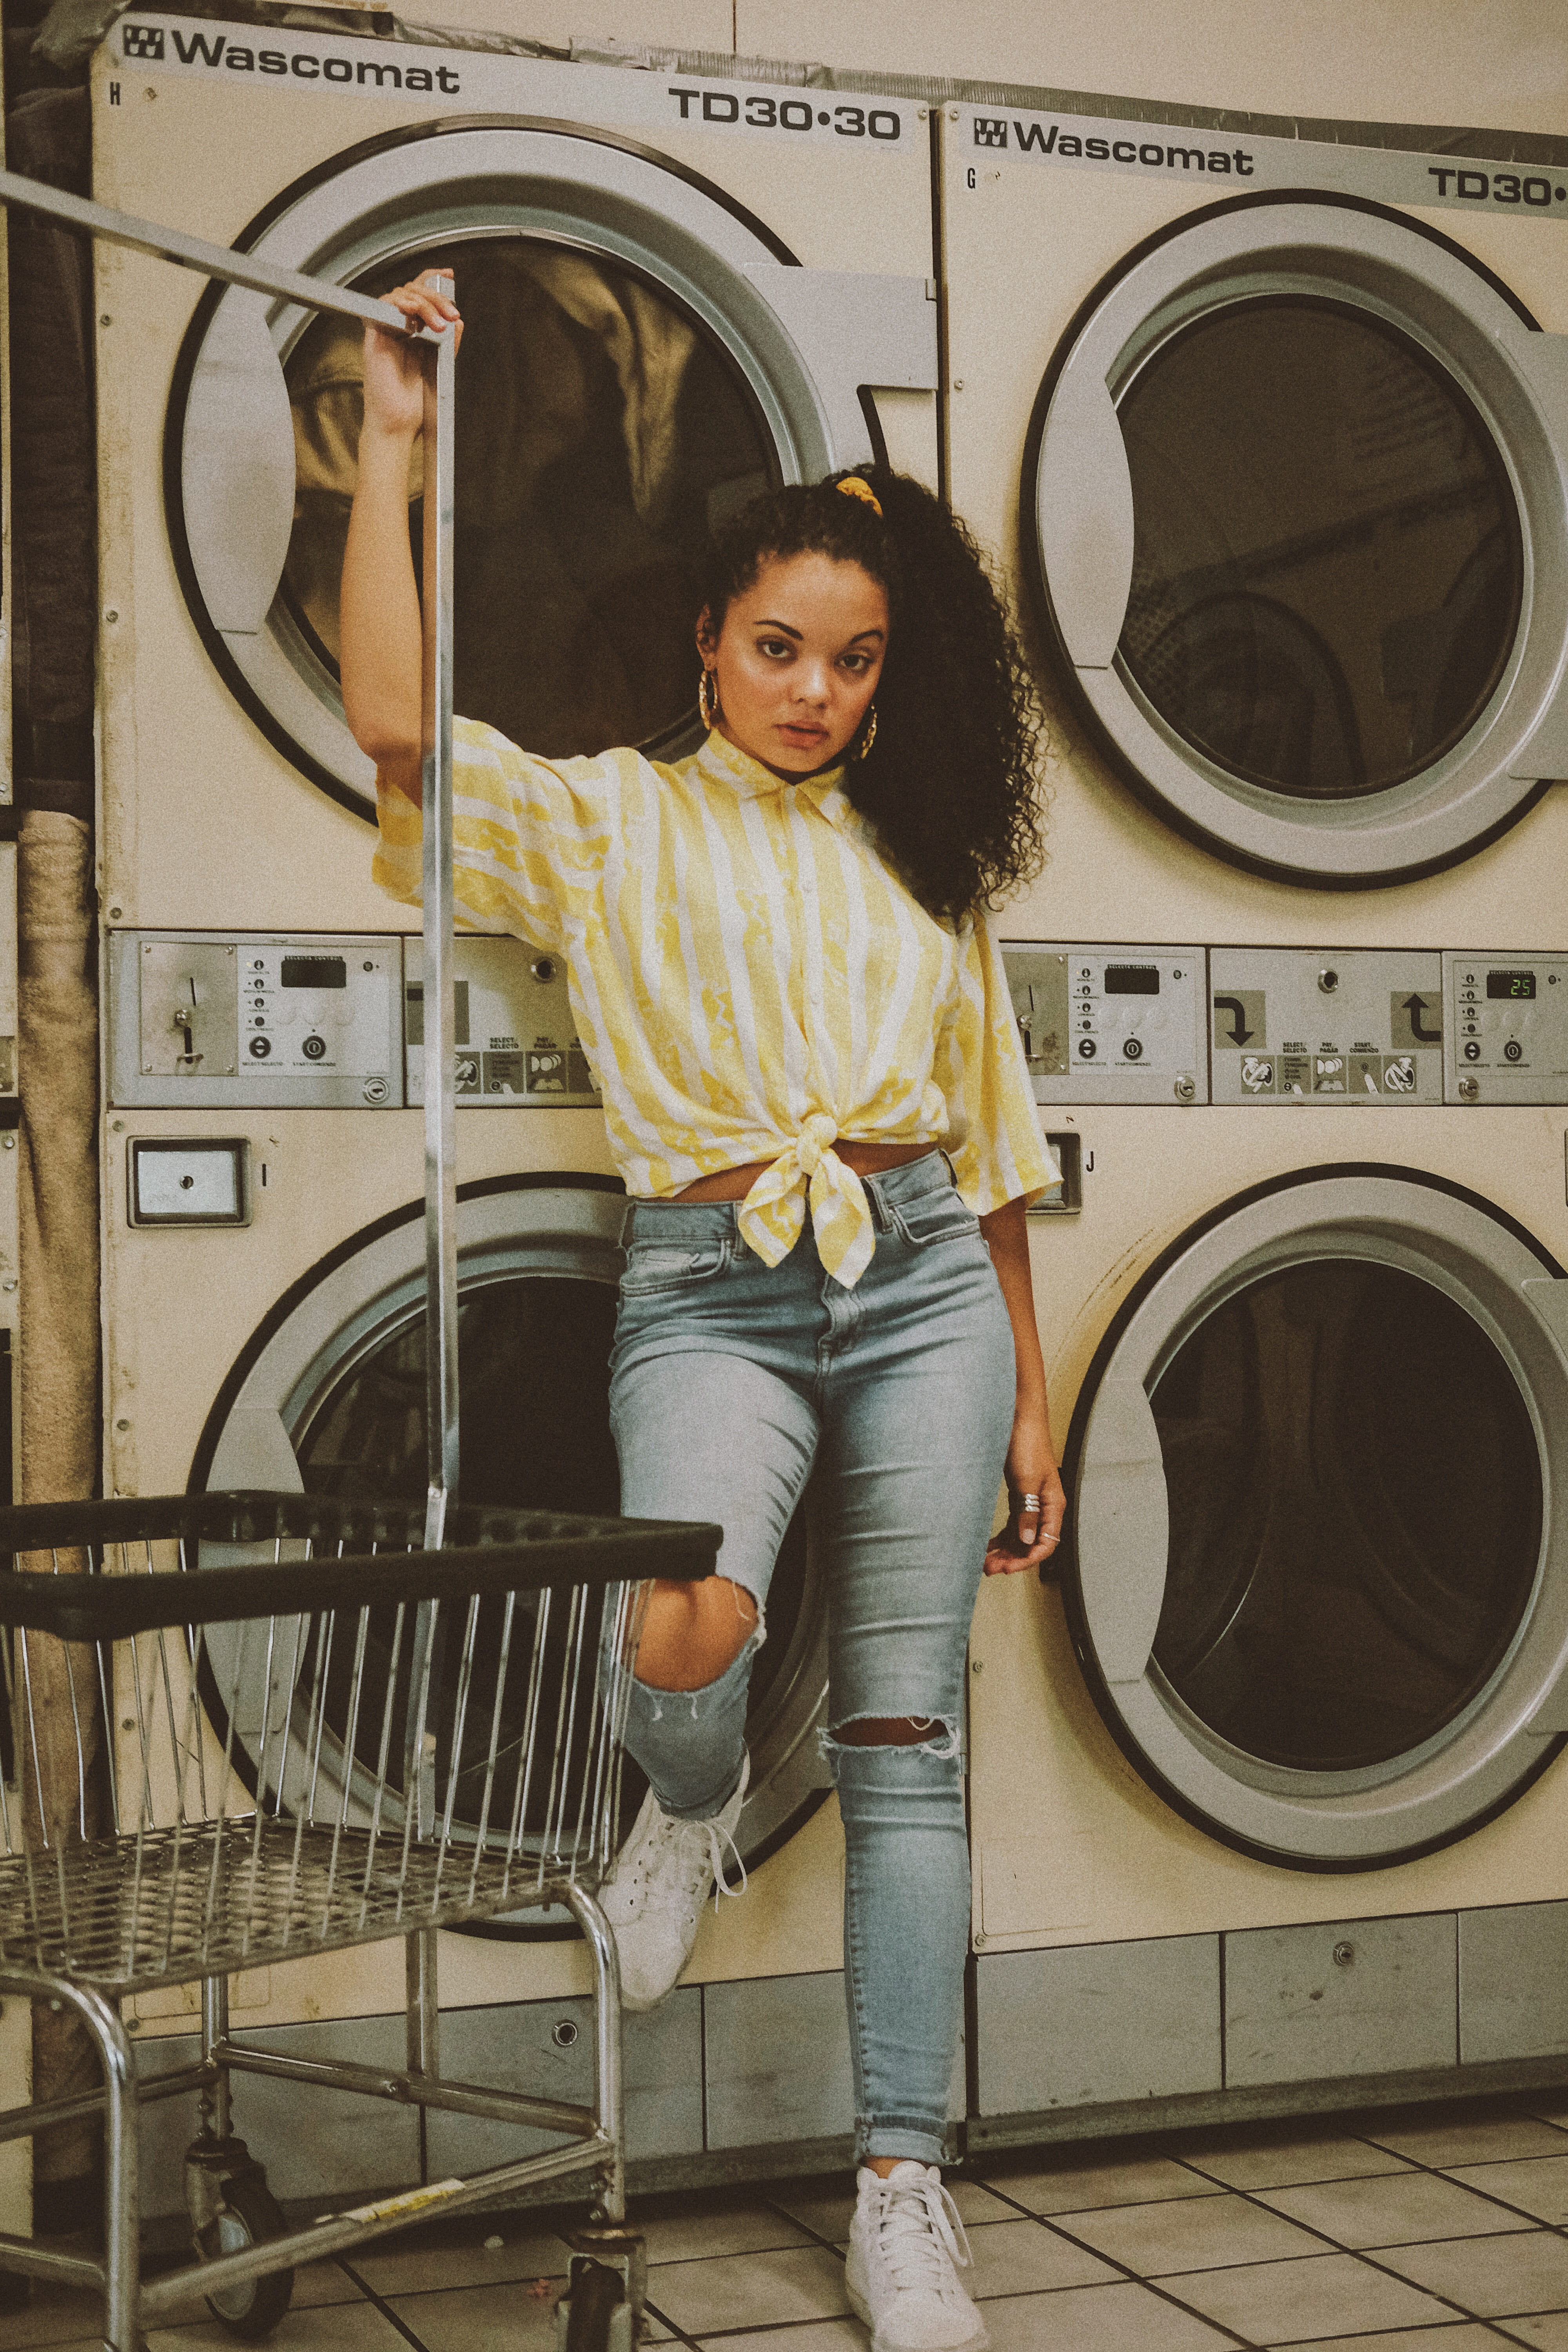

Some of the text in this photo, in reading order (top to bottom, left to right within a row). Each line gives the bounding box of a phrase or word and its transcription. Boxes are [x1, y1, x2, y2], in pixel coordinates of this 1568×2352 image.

[172, 29, 460, 94] Wascomat
[110, 82, 120, 105] H
[1013, 121, 1254, 176] Wascomat
[967, 168, 975, 189] G
[1511, 979, 1530, 995] 25
[1086, 1151, 1094, 1172] J
